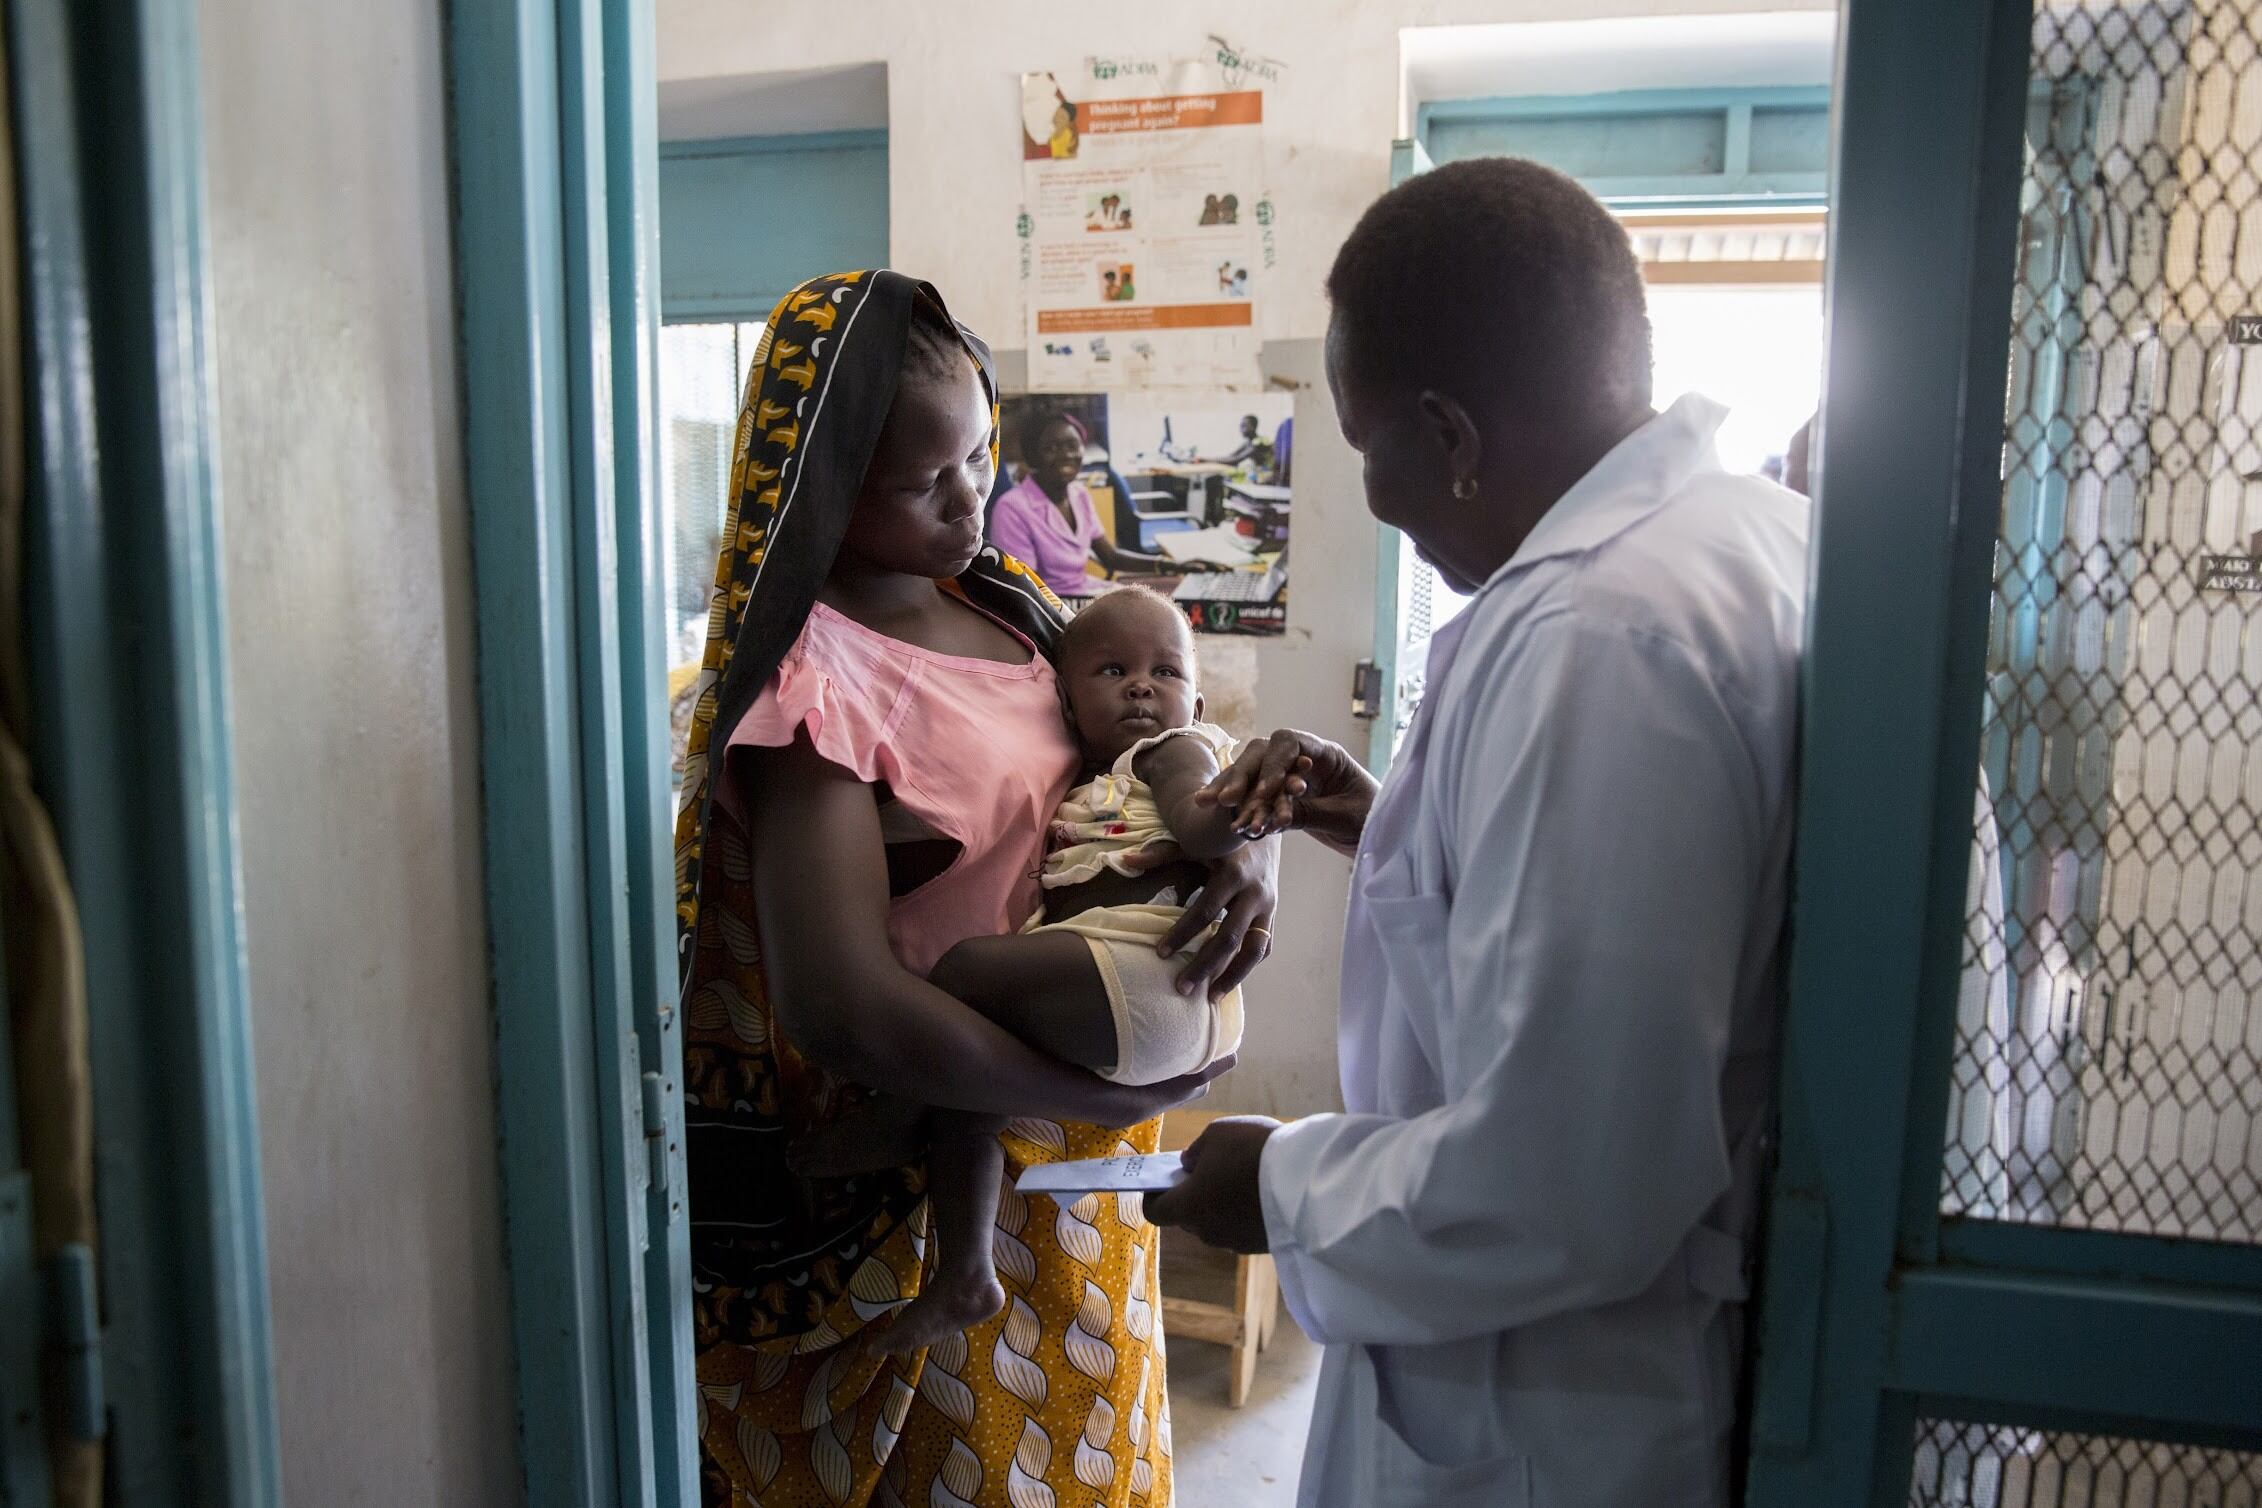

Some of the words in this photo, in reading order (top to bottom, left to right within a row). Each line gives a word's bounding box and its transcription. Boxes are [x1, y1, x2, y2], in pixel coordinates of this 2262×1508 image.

[1089, 102, 1138, 118] Thinking
[1140, 100, 1172, 114] about
[1174, 97, 1217, 113] getting
[1088, 118, 1140, 134] pregnant
[1143, 114, 1180, 131] again?
[1239, 605, 1271, 618] unicef
